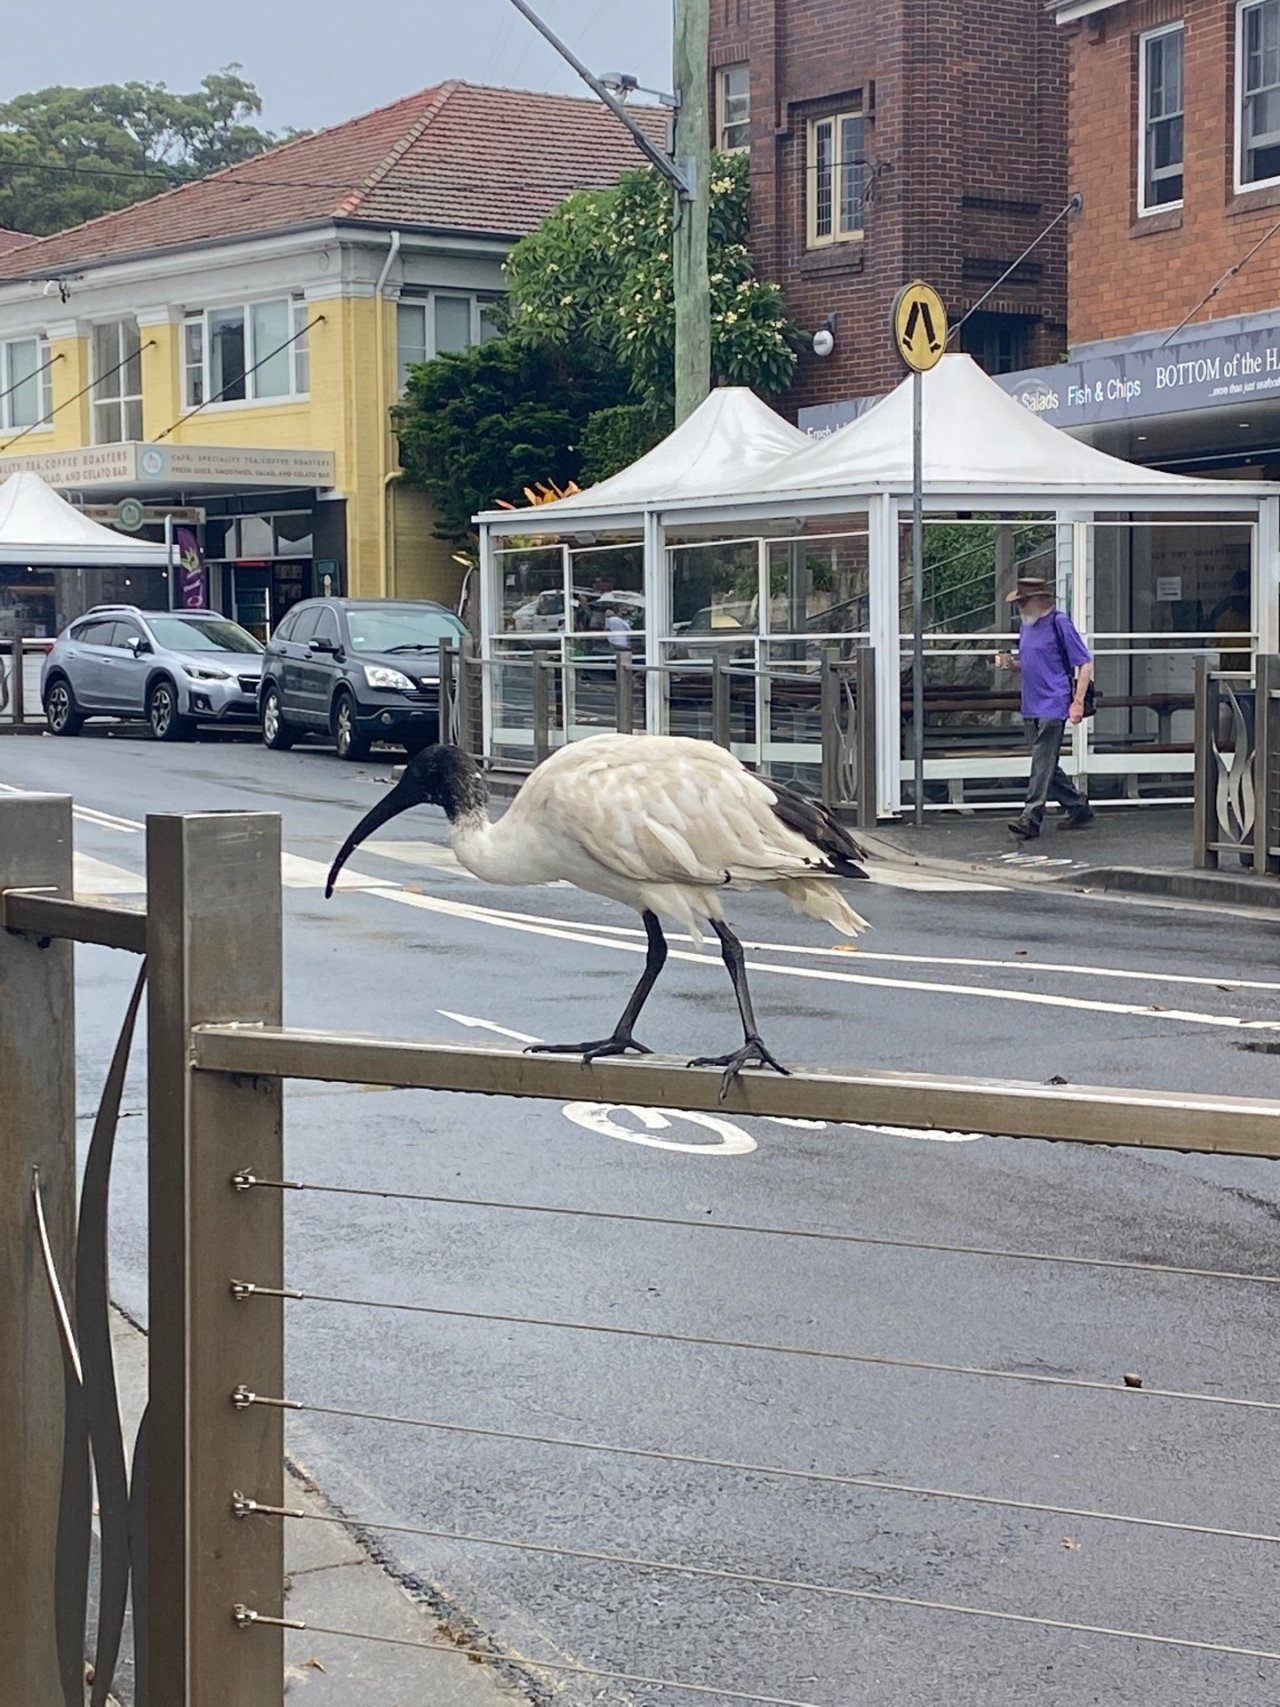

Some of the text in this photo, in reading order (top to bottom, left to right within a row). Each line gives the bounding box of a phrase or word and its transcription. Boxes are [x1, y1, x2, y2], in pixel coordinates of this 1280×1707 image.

[1155, 347, 1280, 389] BOTTOM of the H
[1021, 389, 1059, 412] Salads
[1067, 377, 1141, 406] Fish & Chips
[82, 450, 127, 465] ROASTERS
[65, 471, 81, 481] AND
[82, 467, 112, 480] GELATO
[113, 465, 128, 477] BAR
